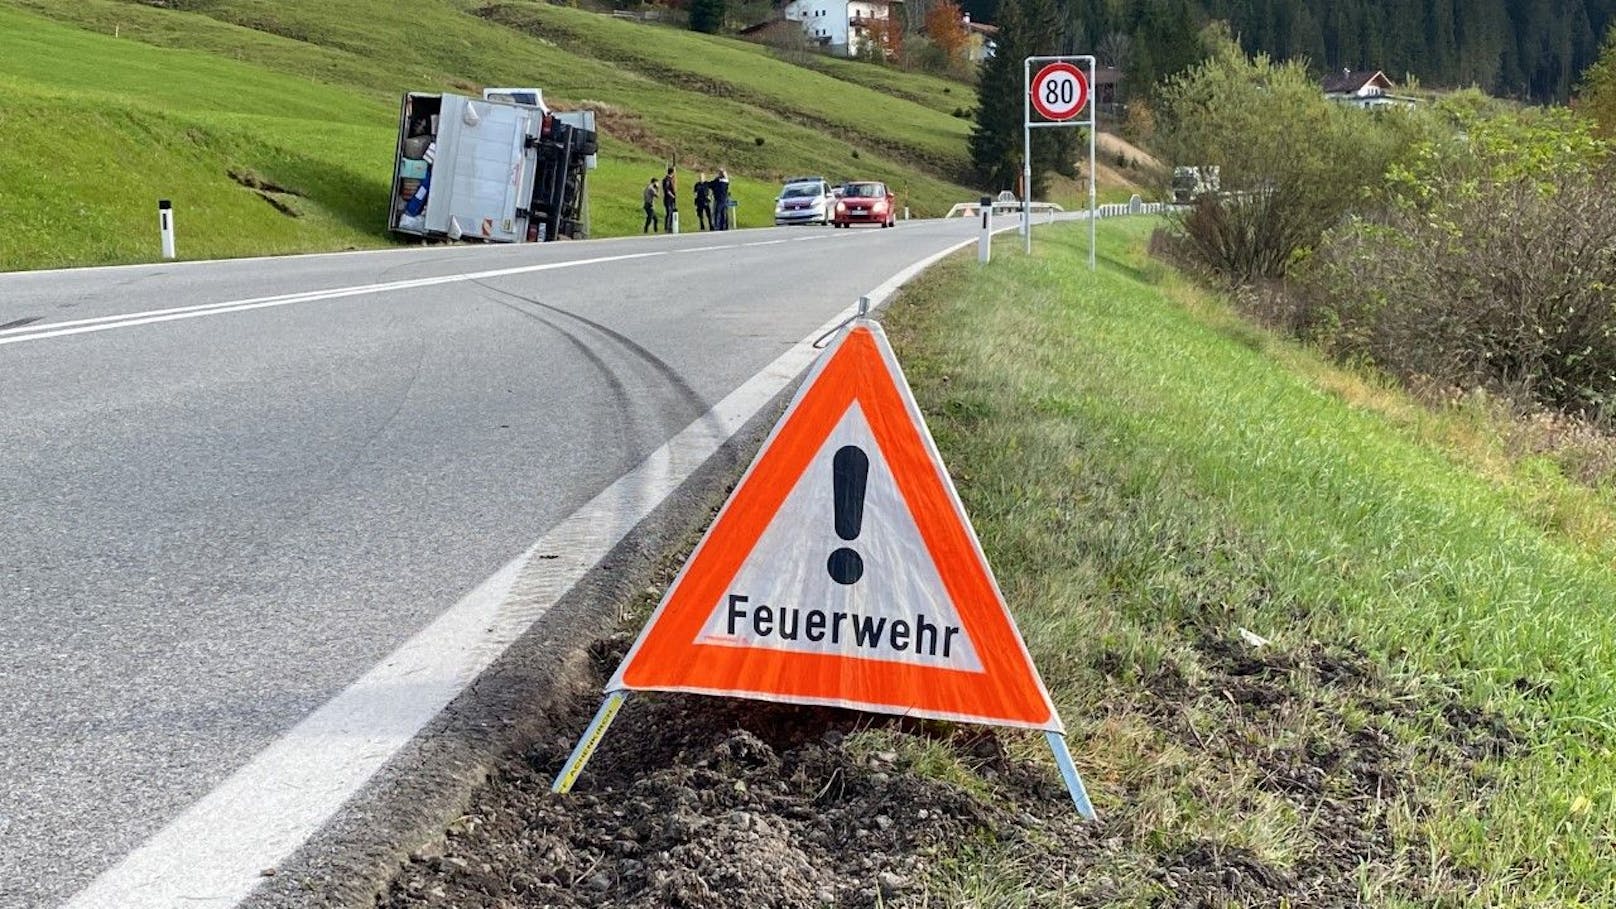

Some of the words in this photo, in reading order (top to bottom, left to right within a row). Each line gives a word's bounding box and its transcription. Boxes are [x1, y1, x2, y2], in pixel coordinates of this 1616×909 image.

[1046, 79, 1073, 104] 80
[727, 594, 959, 658] Feuerwehr
[569, 709, 613, 778] ACHENKIRCH
